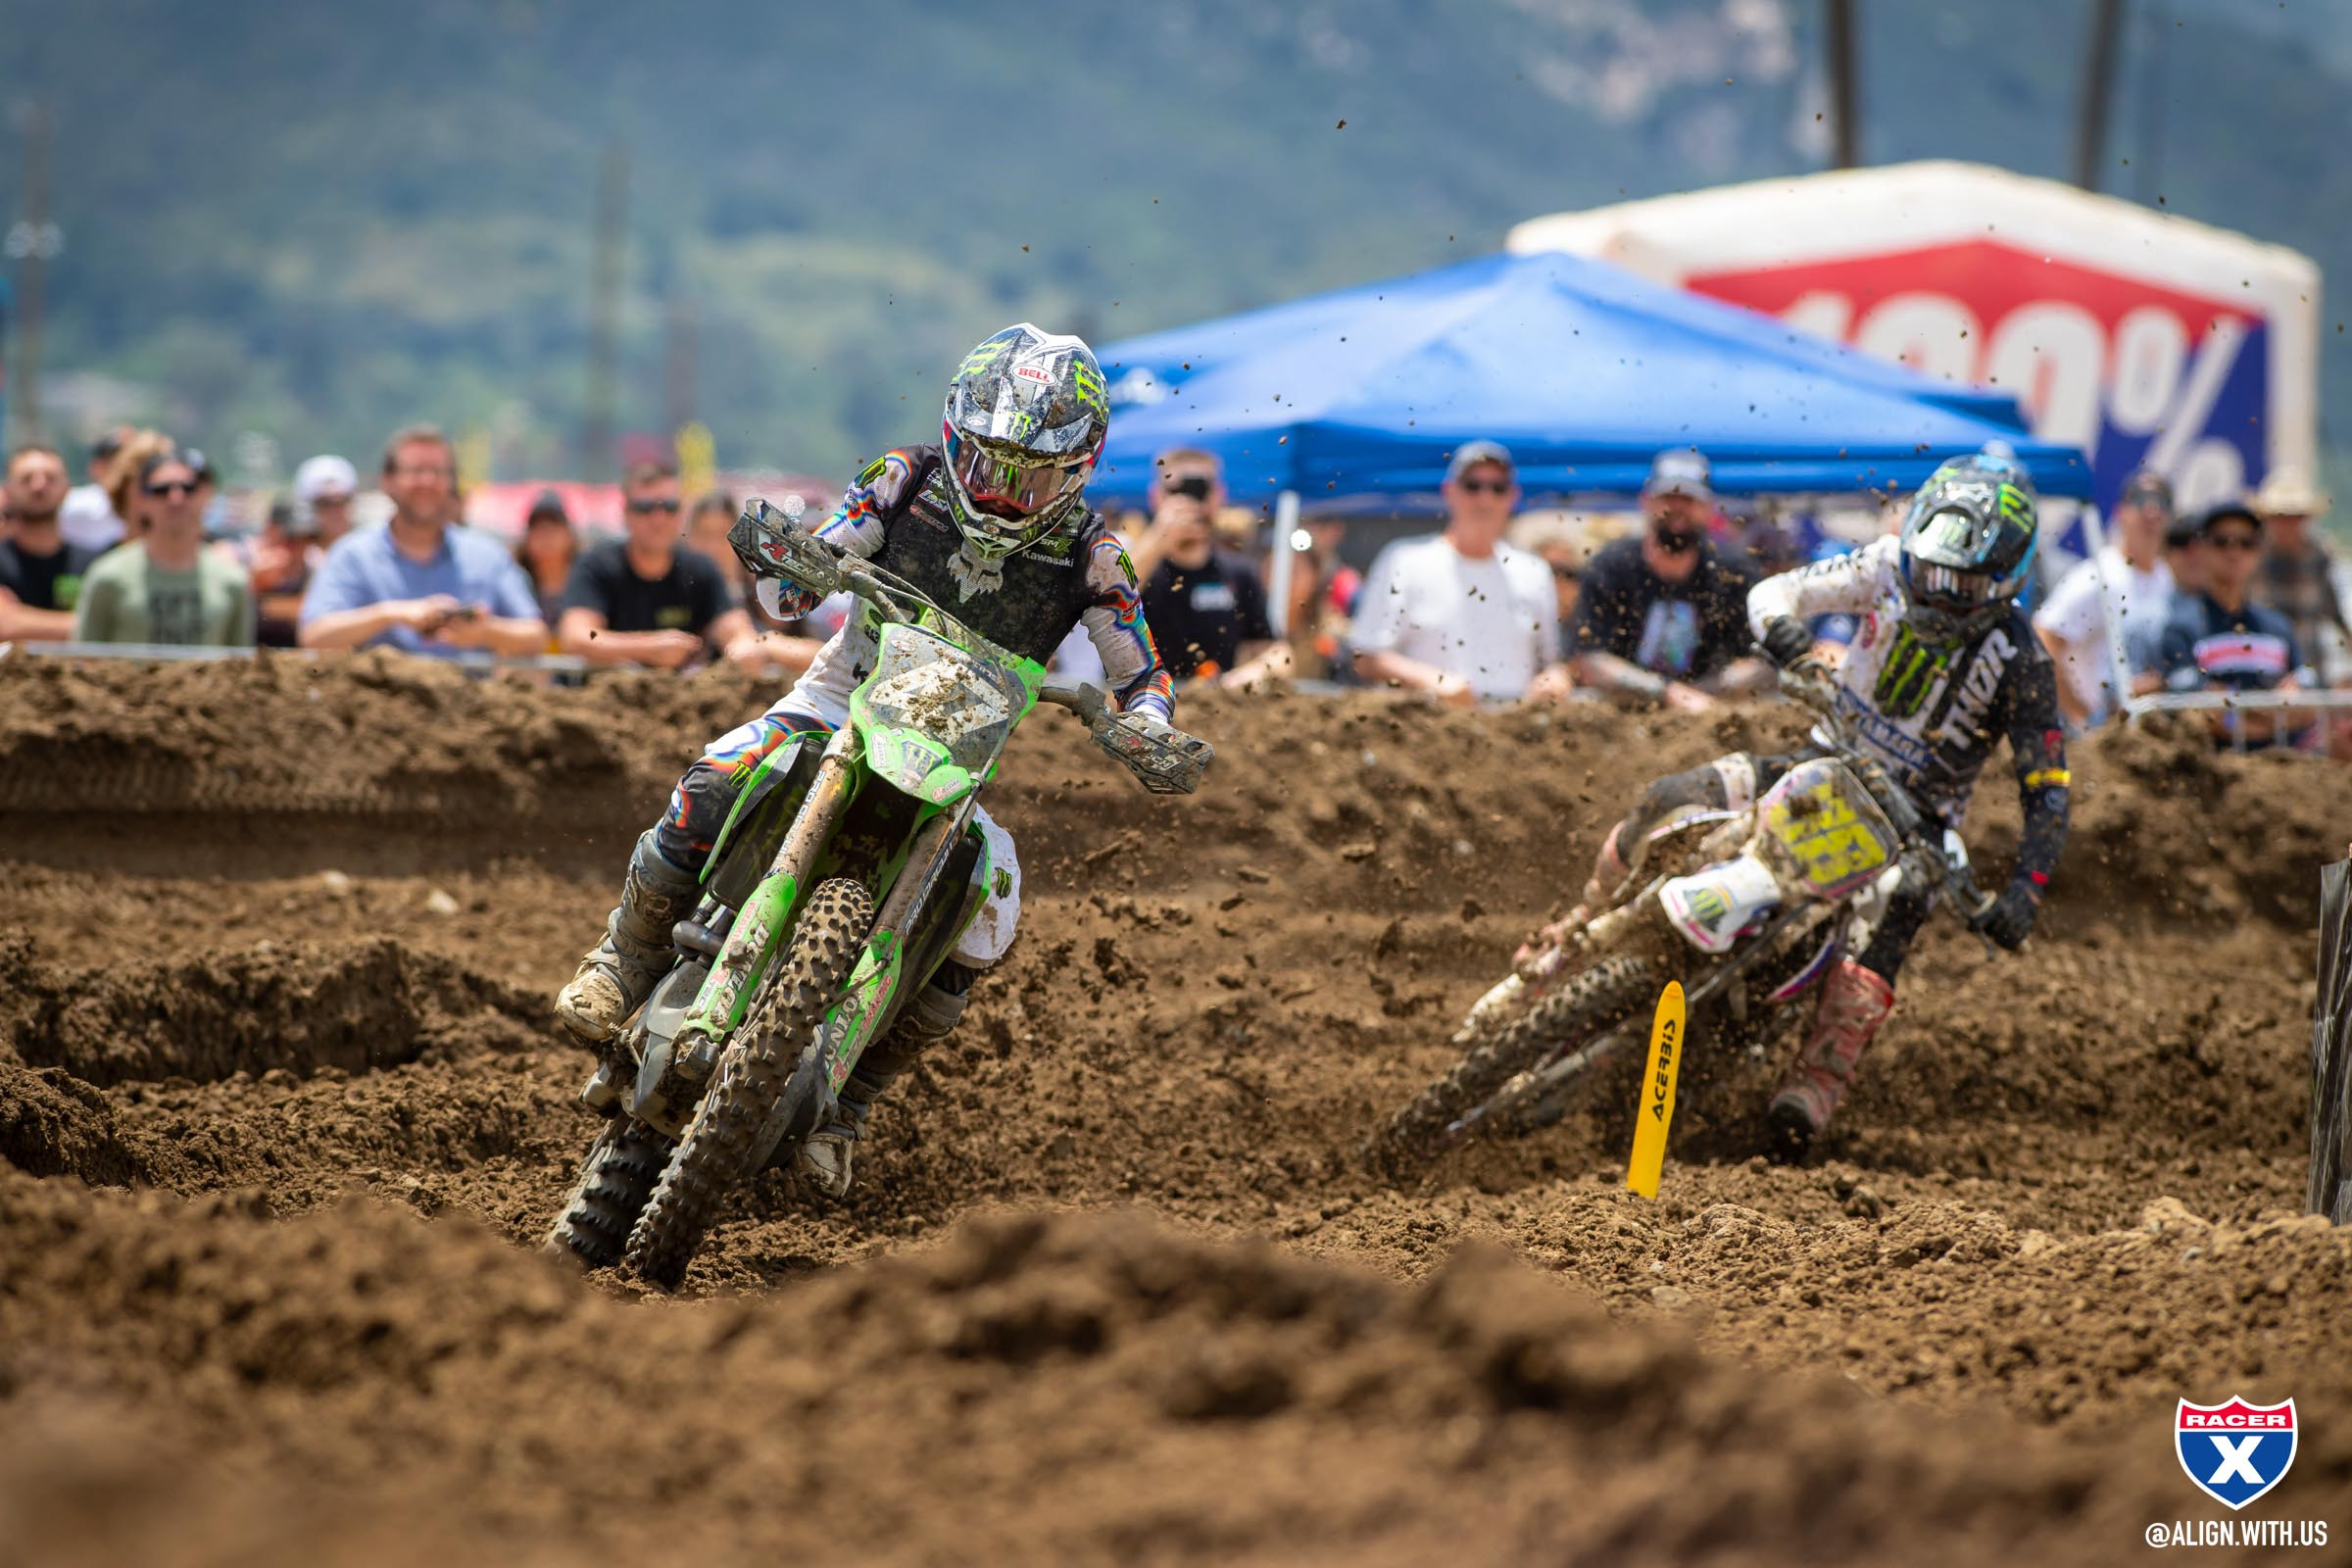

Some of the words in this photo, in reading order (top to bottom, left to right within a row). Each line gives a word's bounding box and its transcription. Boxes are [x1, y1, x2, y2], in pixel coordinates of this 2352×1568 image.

[1018, 368, 1050, 383] BELL
[1021, 549, 1075, 567] Kawasaki
[905, 899, 925, 937] PRO
[1652, 1019, 1676, 1122] ACERBIS
